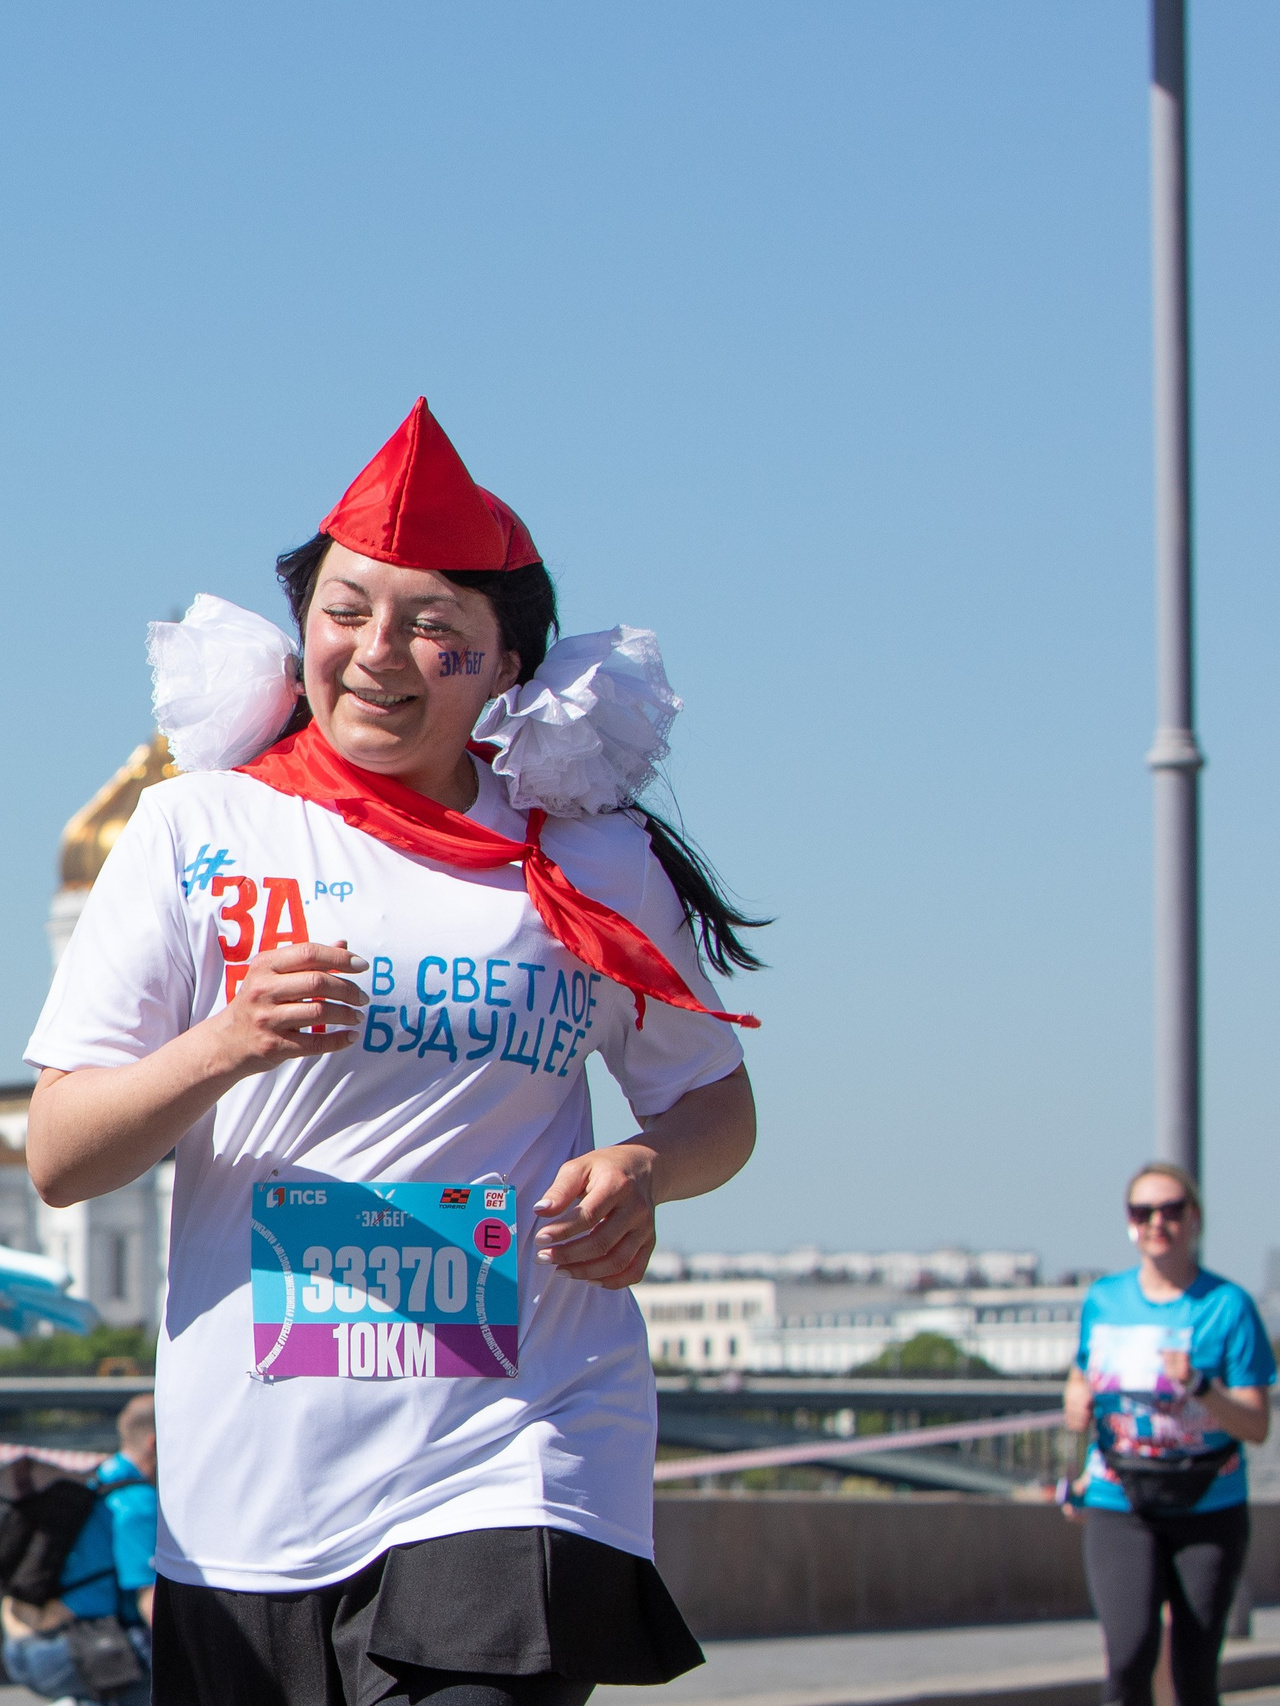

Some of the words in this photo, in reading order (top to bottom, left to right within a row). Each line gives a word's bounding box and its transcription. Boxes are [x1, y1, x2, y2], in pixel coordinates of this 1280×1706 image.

[438, 650, 462, 677] ЗА
[465, 650, 486, 676] БЕГ
[371, 955, 396, 997] В
[416, 955, 602, 1029] СВЕТЛОЕ
[362, 1004, 587, 1078] БУДУЩЕЕ
[289, 1189, 328, 1206] ПСБ
[485, 1192, 504, 1200] FON
[485, 1200, 504, 1208] BET
[301, 1245, 469, 1314] 33370
